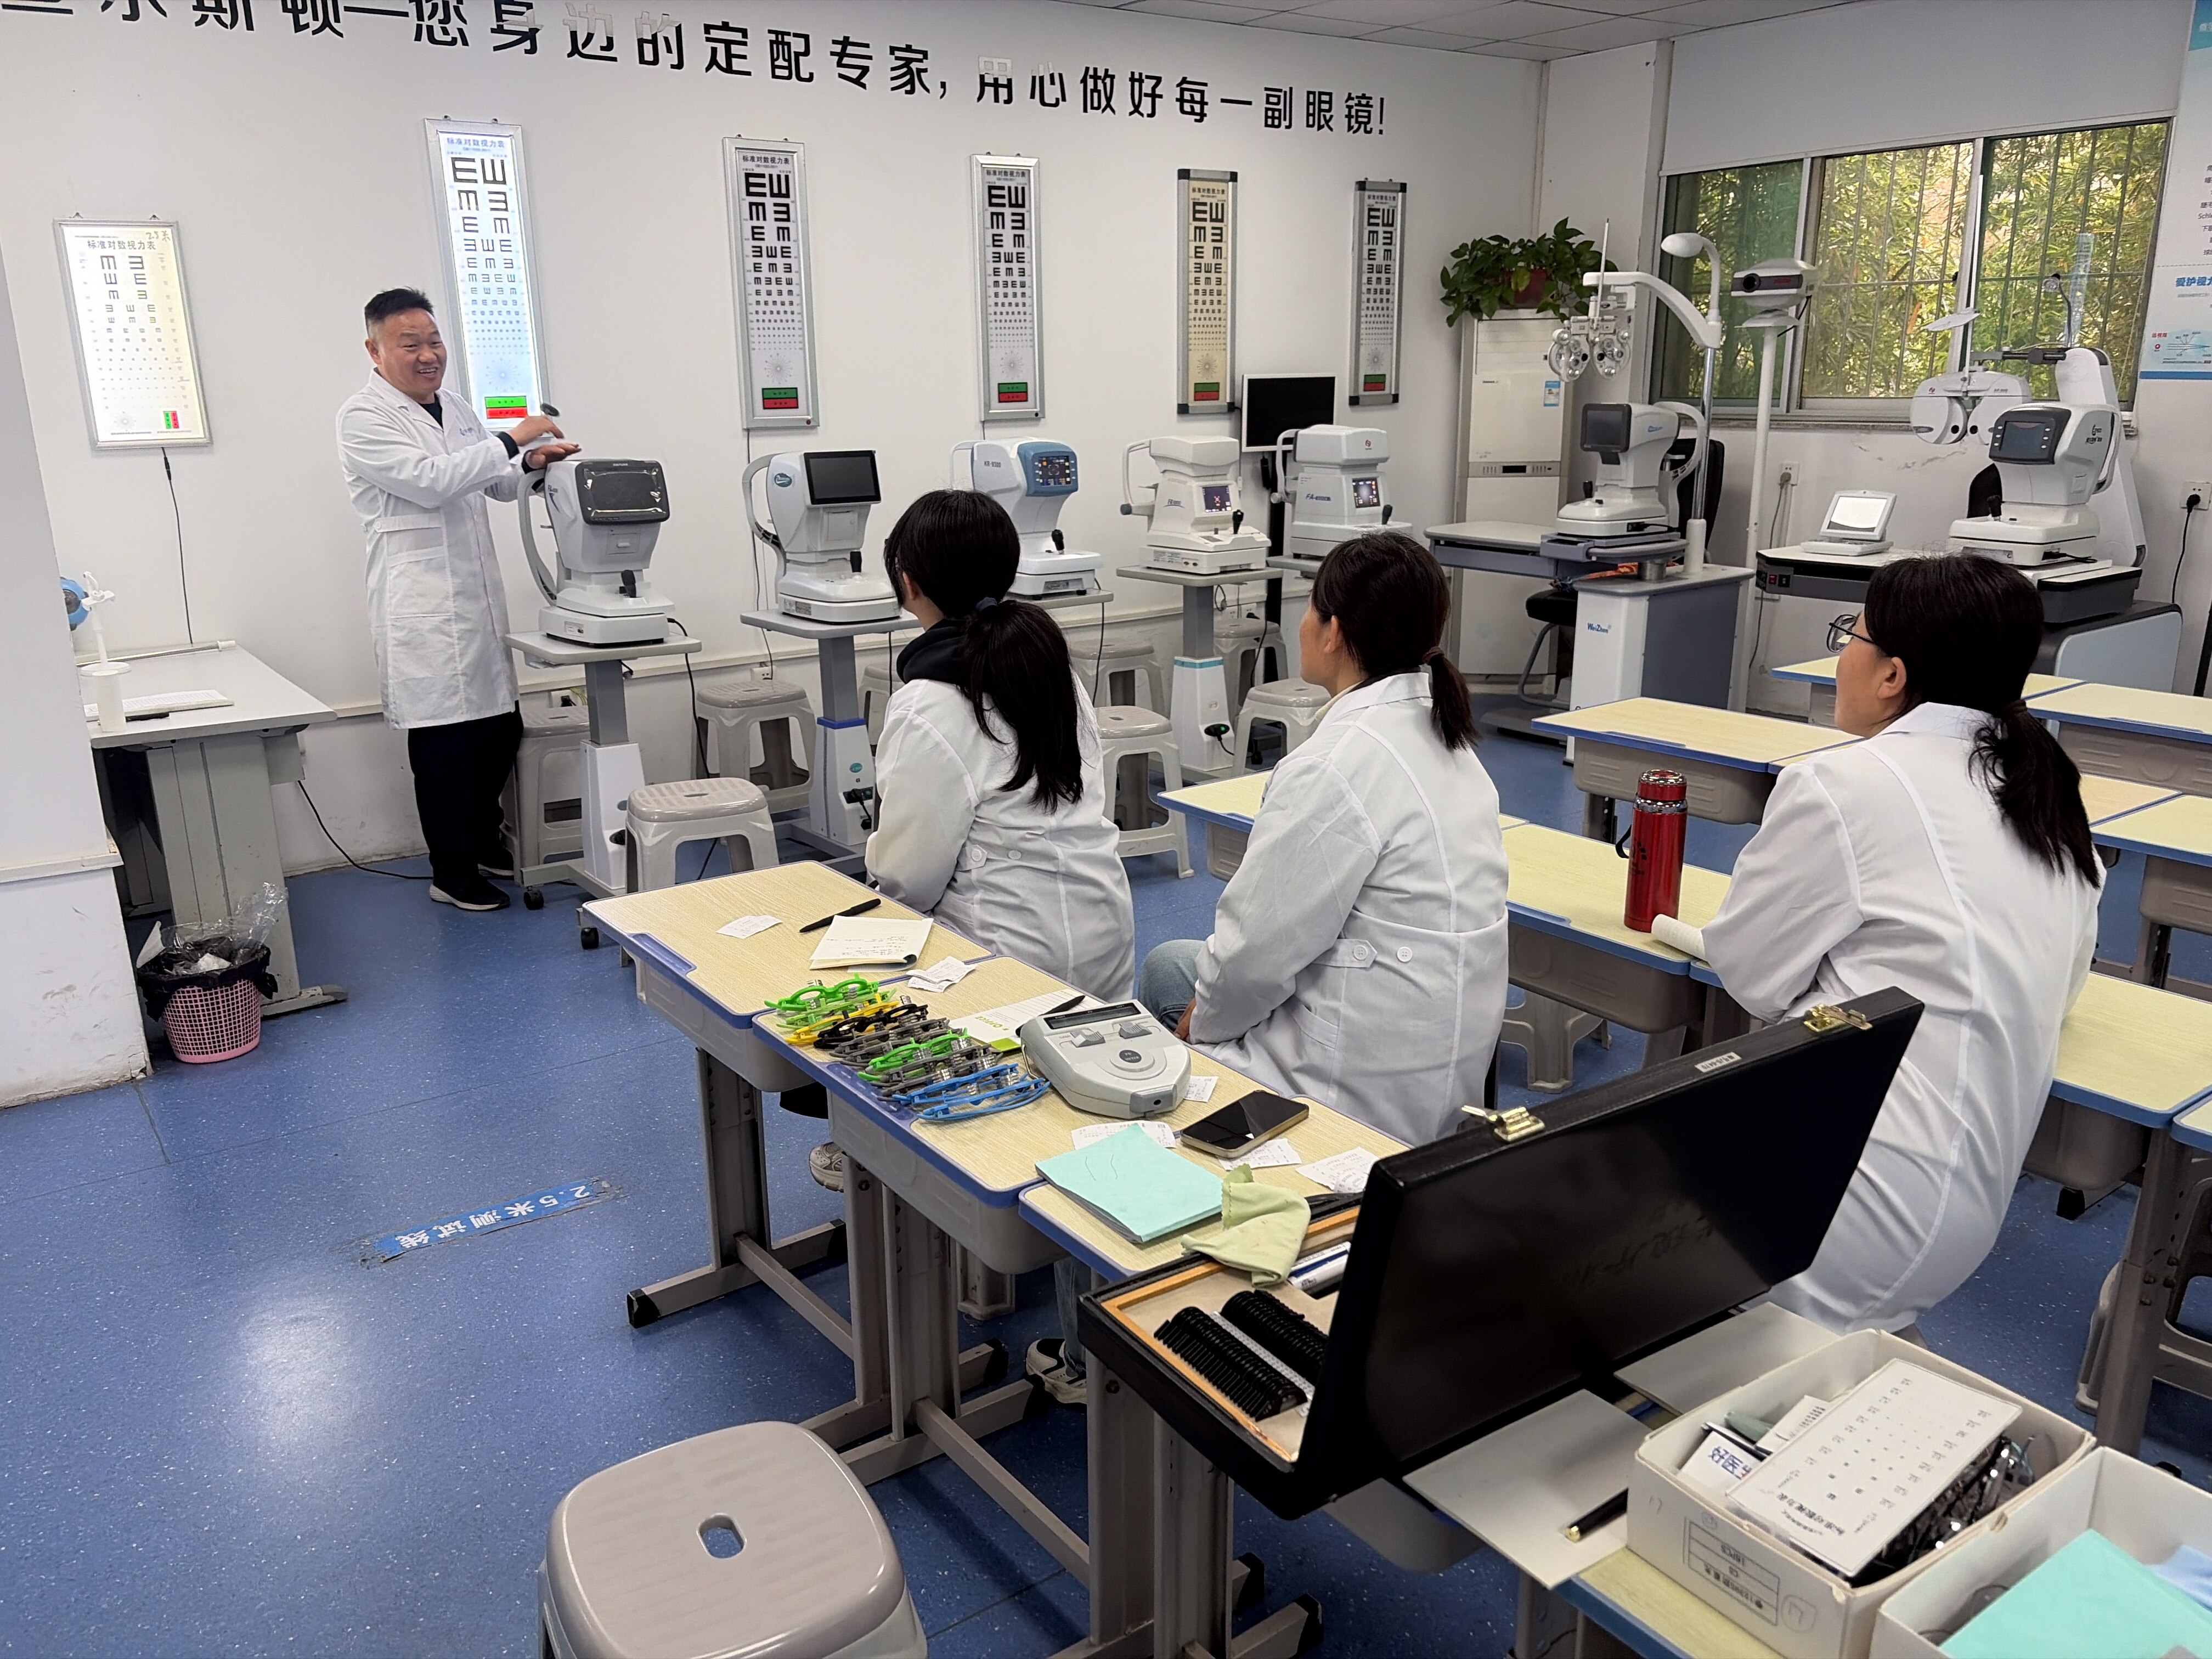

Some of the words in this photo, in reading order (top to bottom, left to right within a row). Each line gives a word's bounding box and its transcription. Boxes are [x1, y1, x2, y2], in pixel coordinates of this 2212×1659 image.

[742, 155, 789, 165] 标准对数视力表
[87, 240, 156, 250] 标准对数视力表
